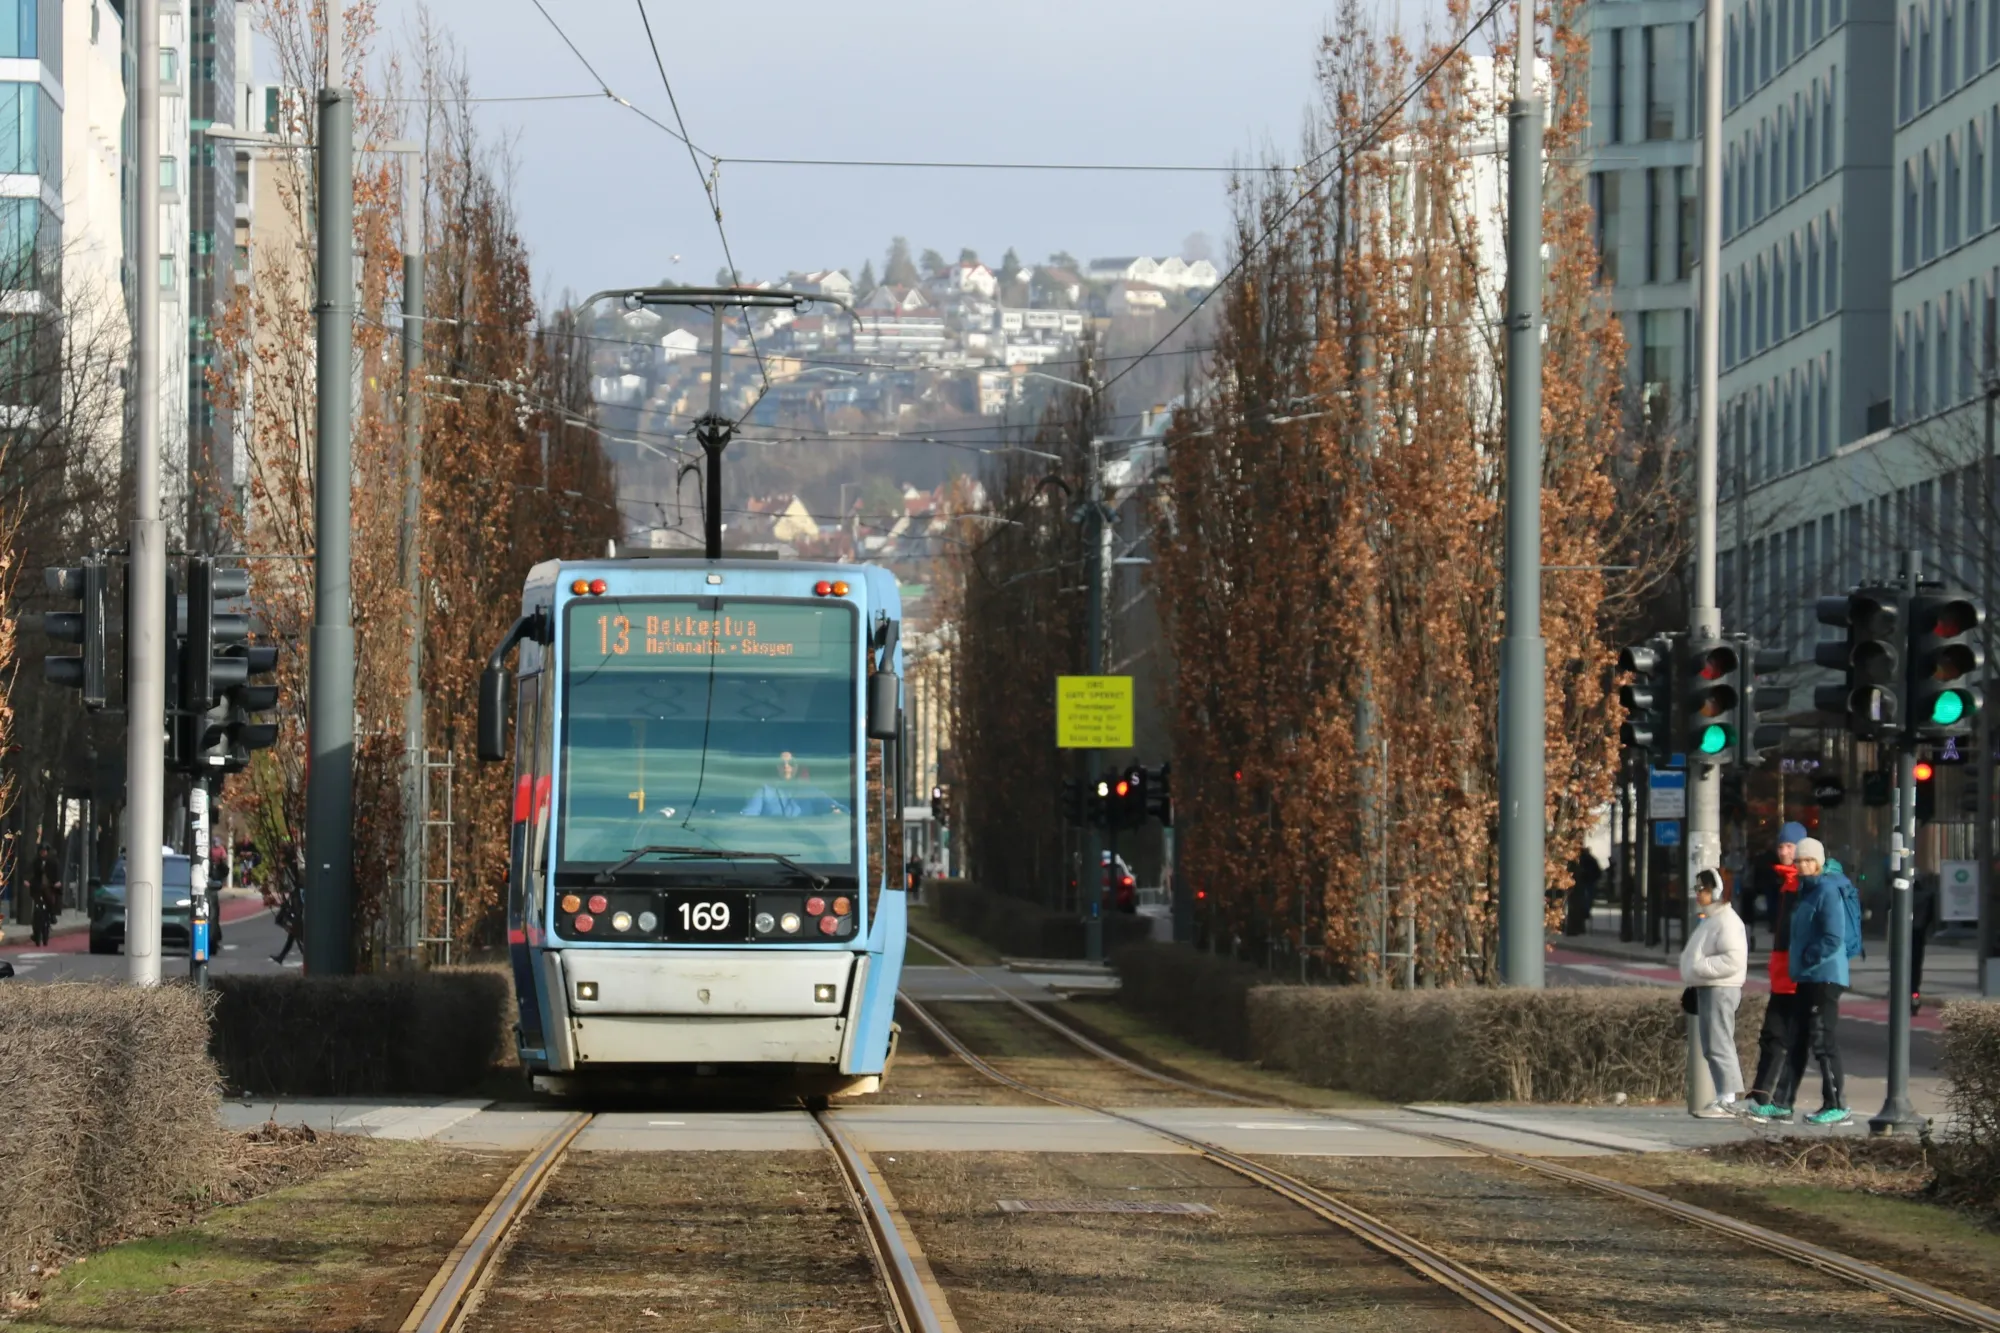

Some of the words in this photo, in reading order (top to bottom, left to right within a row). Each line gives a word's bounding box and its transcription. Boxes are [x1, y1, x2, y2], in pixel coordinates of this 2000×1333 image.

[598, 615, 630, 655] 13
[646, 615, 757, 636] Bekkestua
[678, 901, 730, 931] 169
